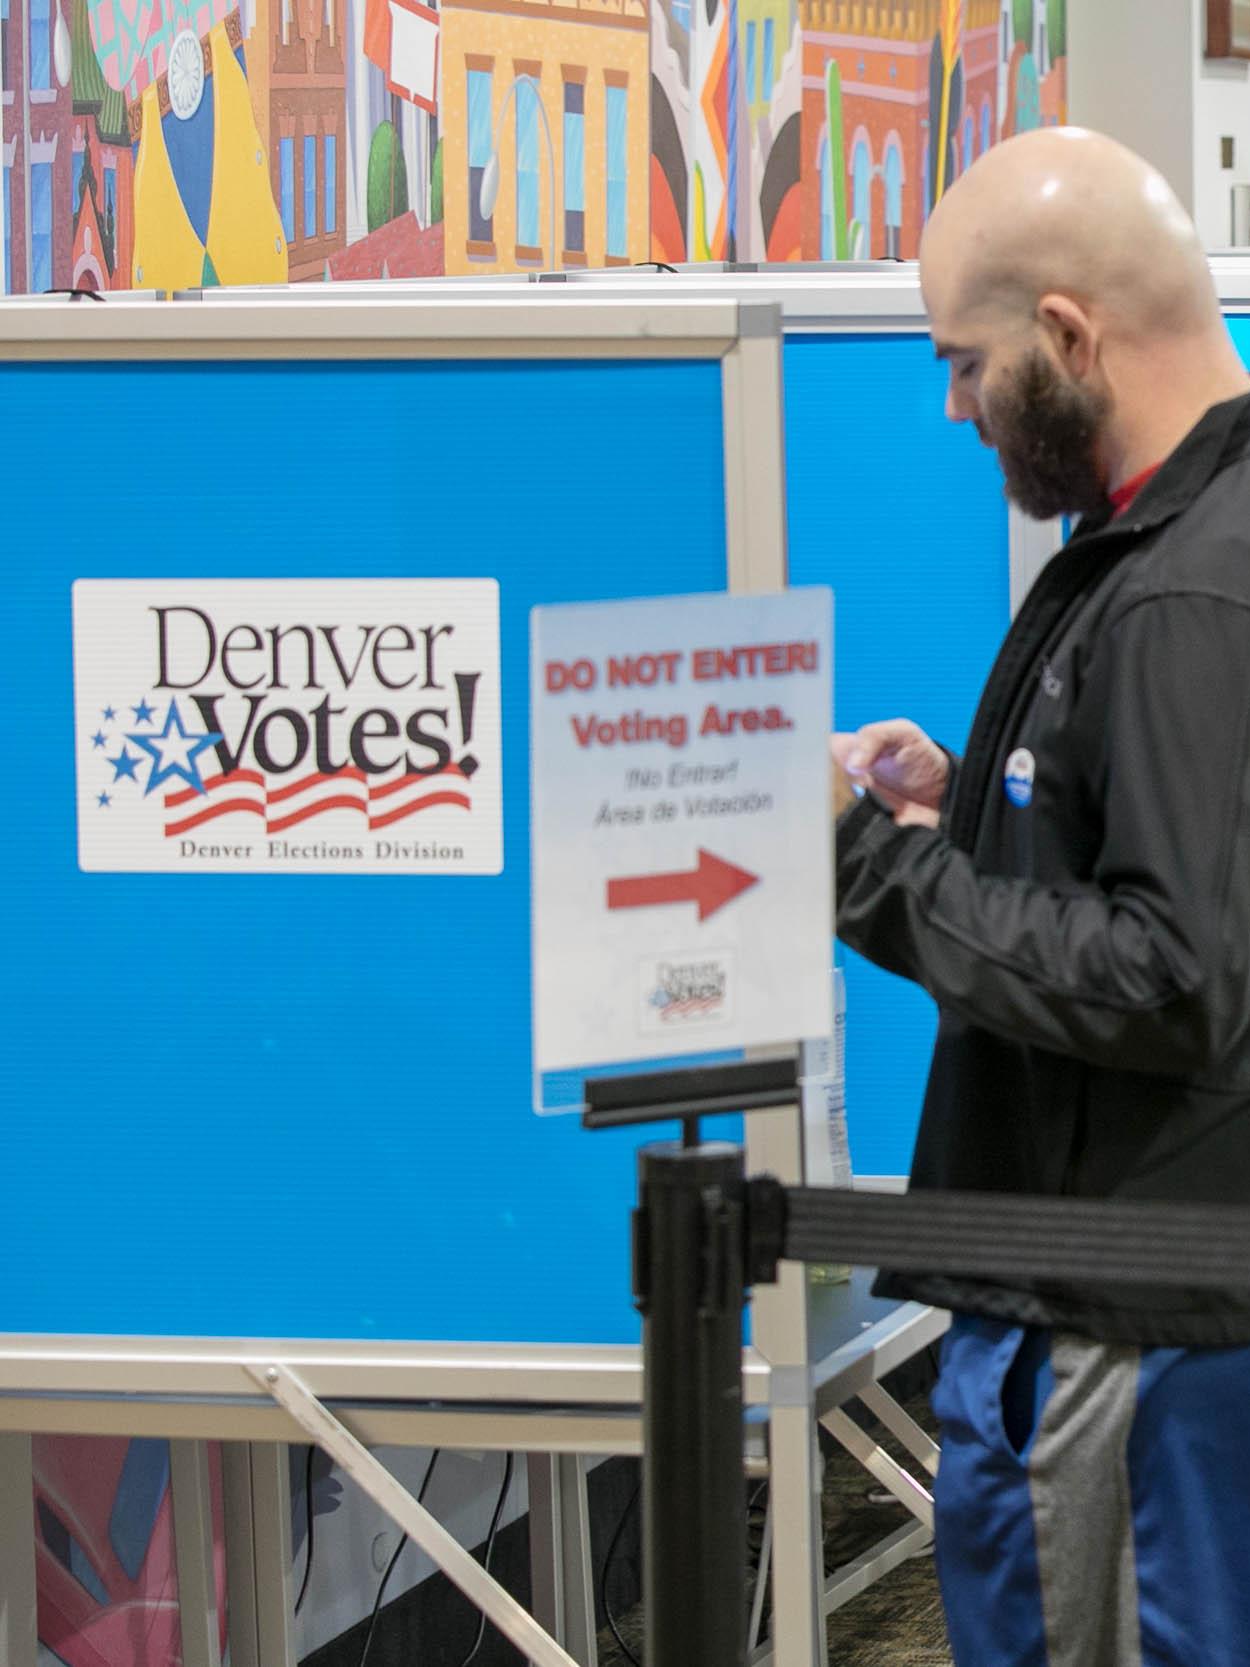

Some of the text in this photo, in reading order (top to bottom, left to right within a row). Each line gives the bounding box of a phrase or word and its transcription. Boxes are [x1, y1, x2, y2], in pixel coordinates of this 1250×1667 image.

[148, 606, 454, 690] Denver
[544, 641, 818, 693] DO NOT ENTER!
[189, 672, 483, 781] Votes!
[571, 704, 794, 749] Voting Area.
[652, 800, 678, 822] de
[180, 840, 465, 861] Denver Elections Division
